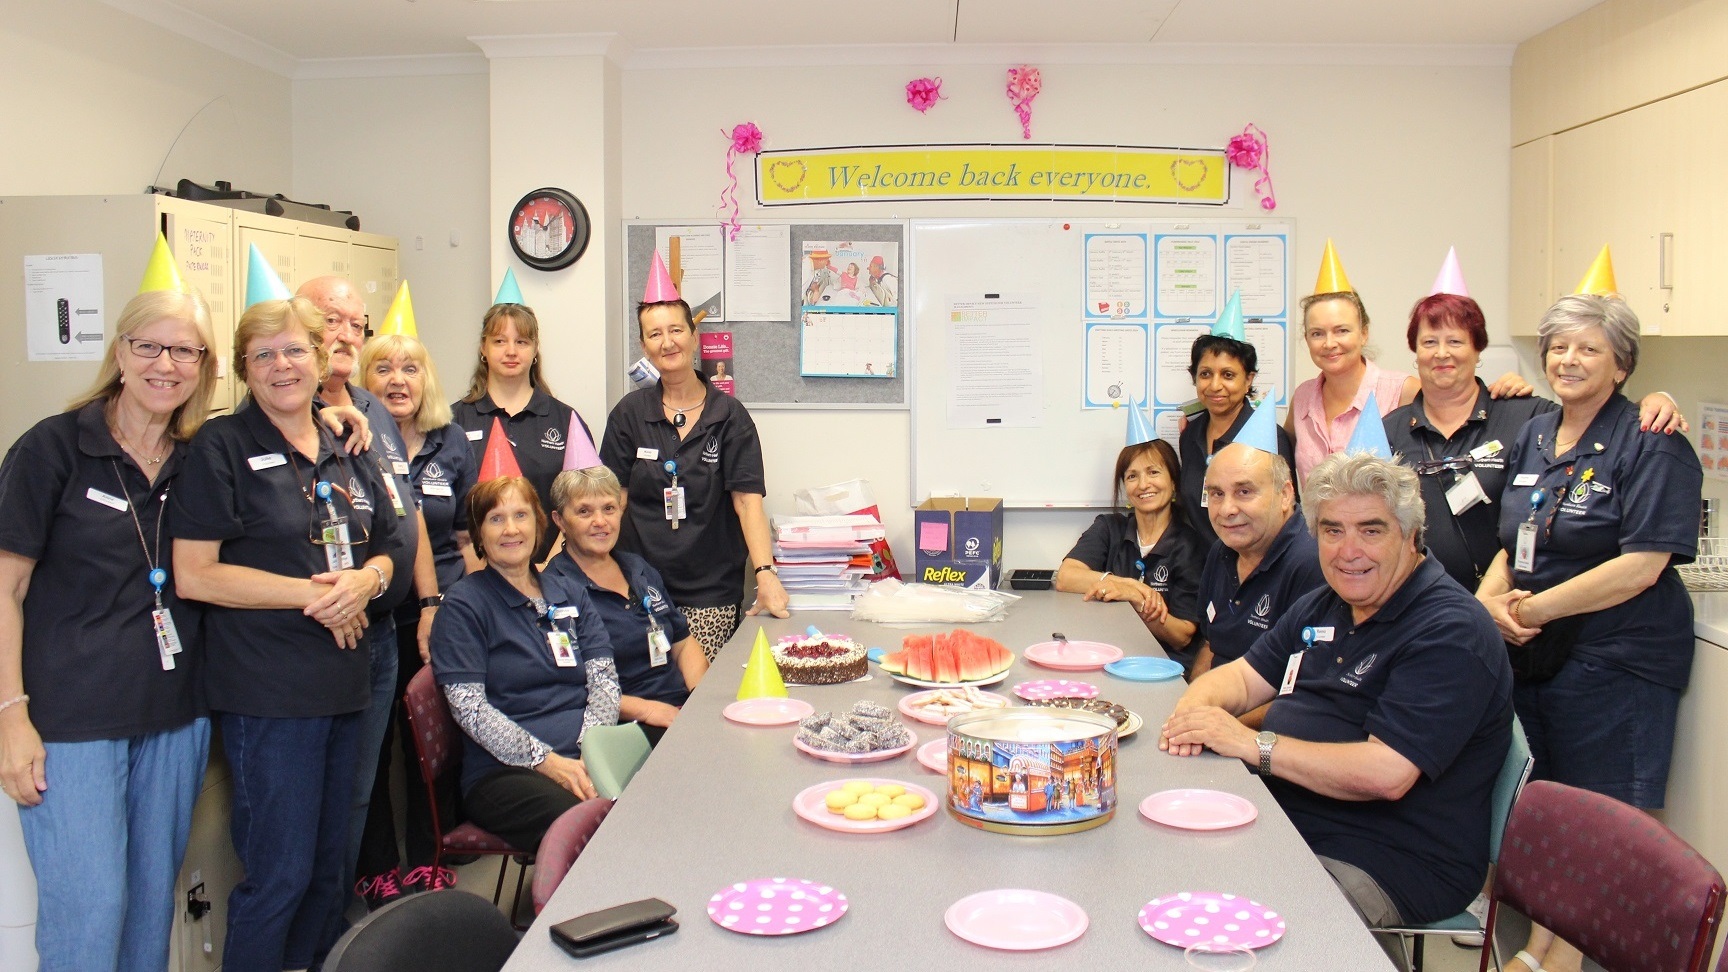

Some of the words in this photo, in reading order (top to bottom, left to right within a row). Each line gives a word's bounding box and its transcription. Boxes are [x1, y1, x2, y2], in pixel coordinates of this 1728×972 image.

[828, 164, 951, 190] Welcome
[958, 162, 1020, 187] back
[1029, 170, 1152, 194] everyone.
[836, 250, 865, 258] January
[1560, 507, 1587, 516] OLUNTEER
[924, 567, 966, 582] Reflex
